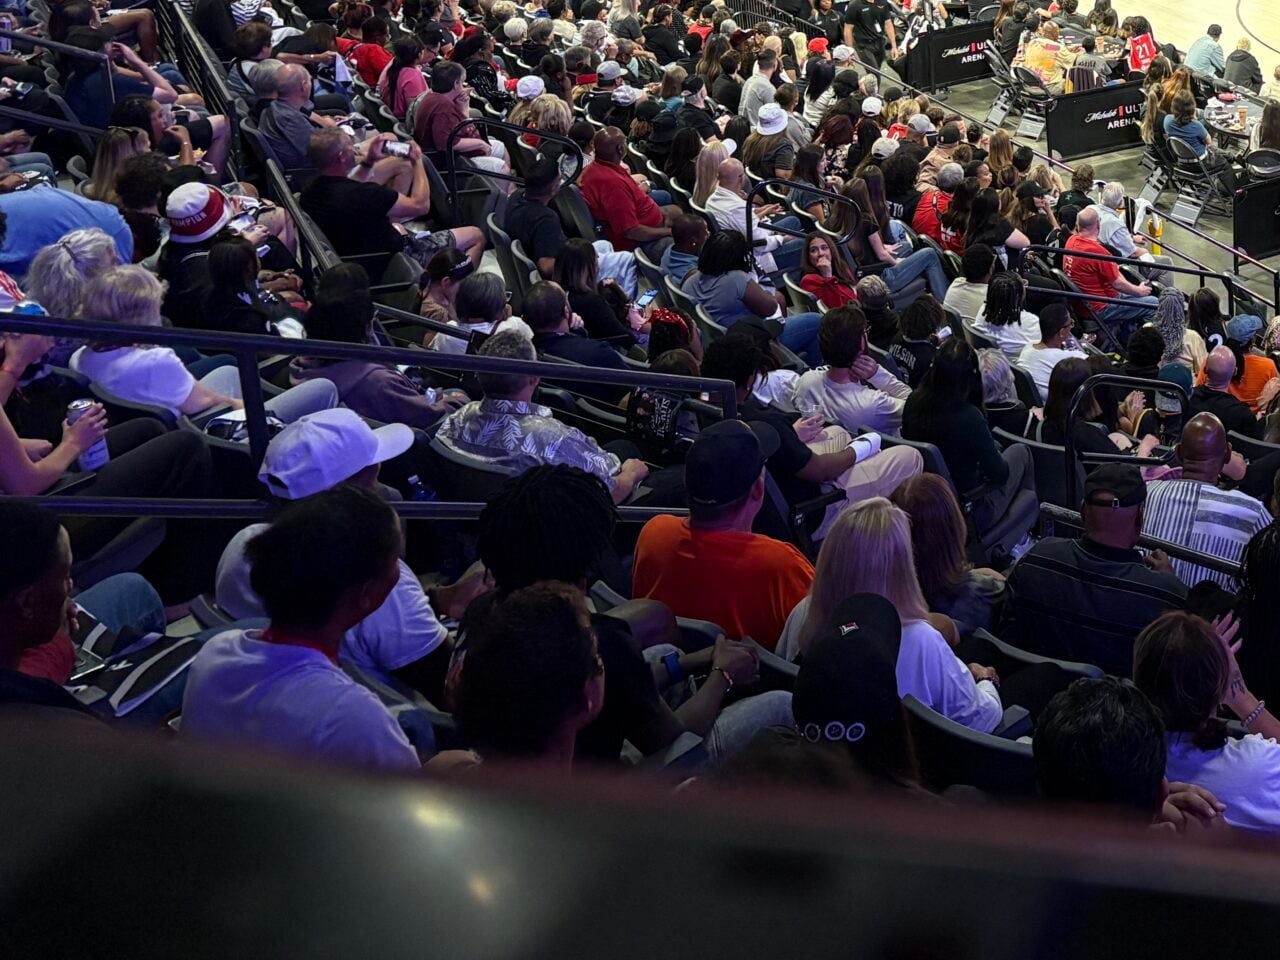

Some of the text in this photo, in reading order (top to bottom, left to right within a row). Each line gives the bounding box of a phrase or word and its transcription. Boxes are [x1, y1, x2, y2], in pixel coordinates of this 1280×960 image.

[941, 42, 970, 59] Michelob
[1136, 43, 1150, 60] 21
[1084, 107, 1117, 124] Michelob
[888, 343, 917, 370] WILSON
